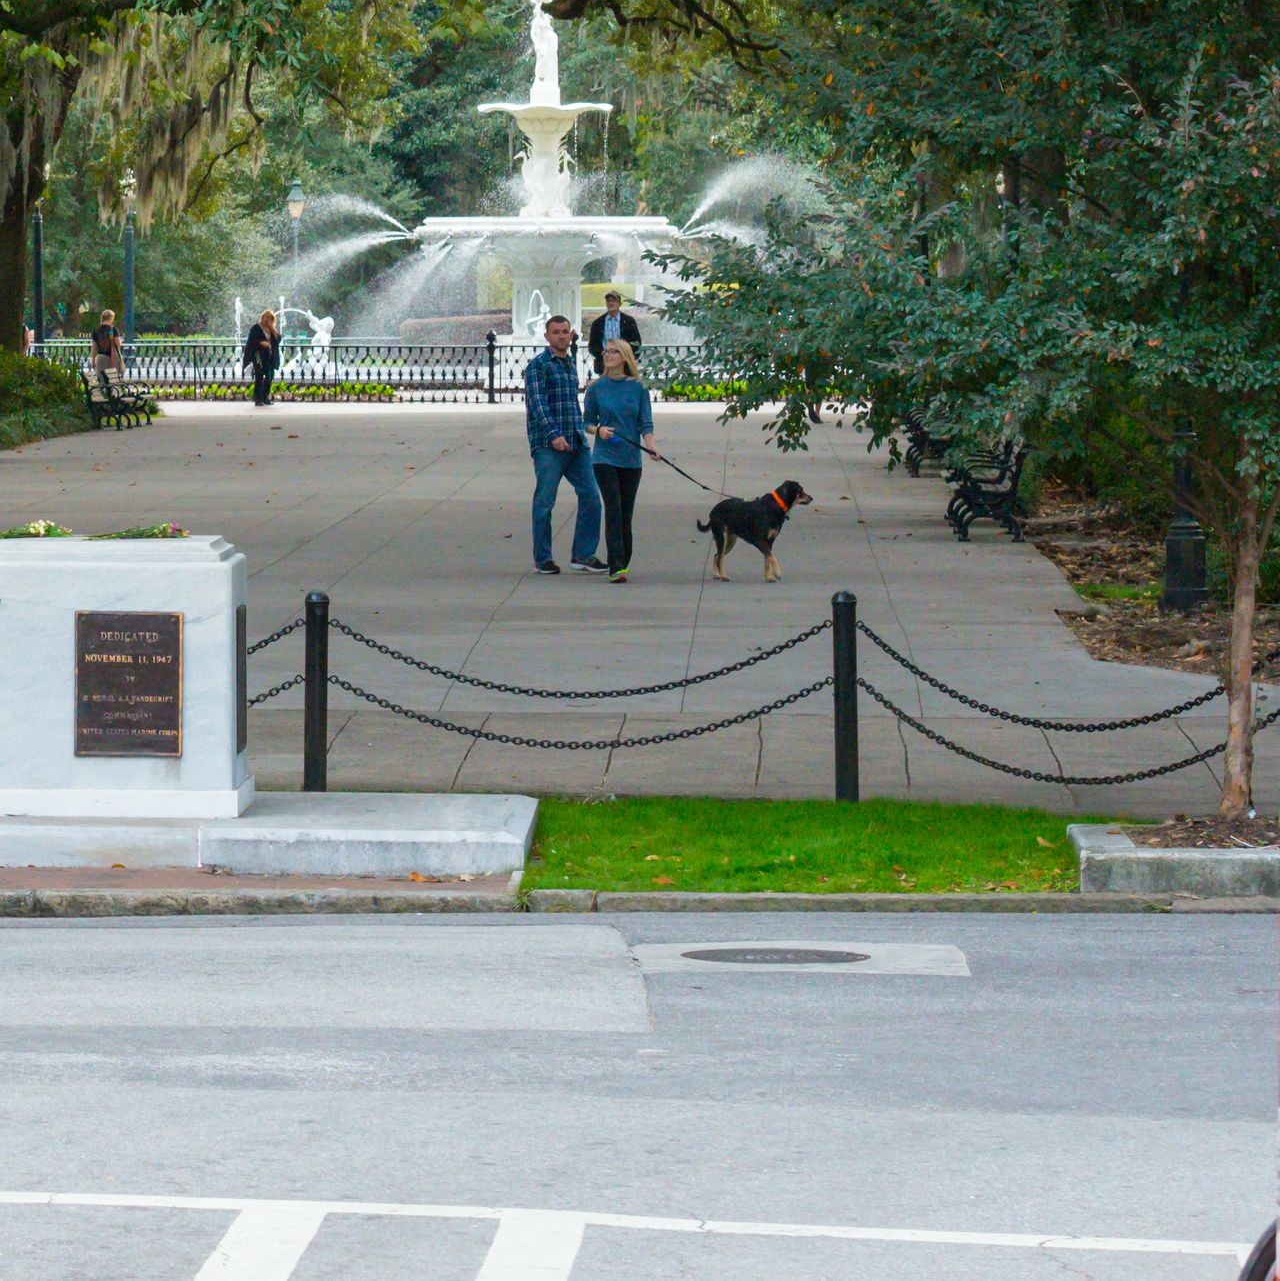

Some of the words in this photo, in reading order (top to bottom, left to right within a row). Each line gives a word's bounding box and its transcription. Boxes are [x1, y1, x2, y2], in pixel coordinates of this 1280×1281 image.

[100, 631, 159, 643] DEDICATED
[85, 654, 133, 664] NOVEMBER
[152, 655, 172, 664] 1947
